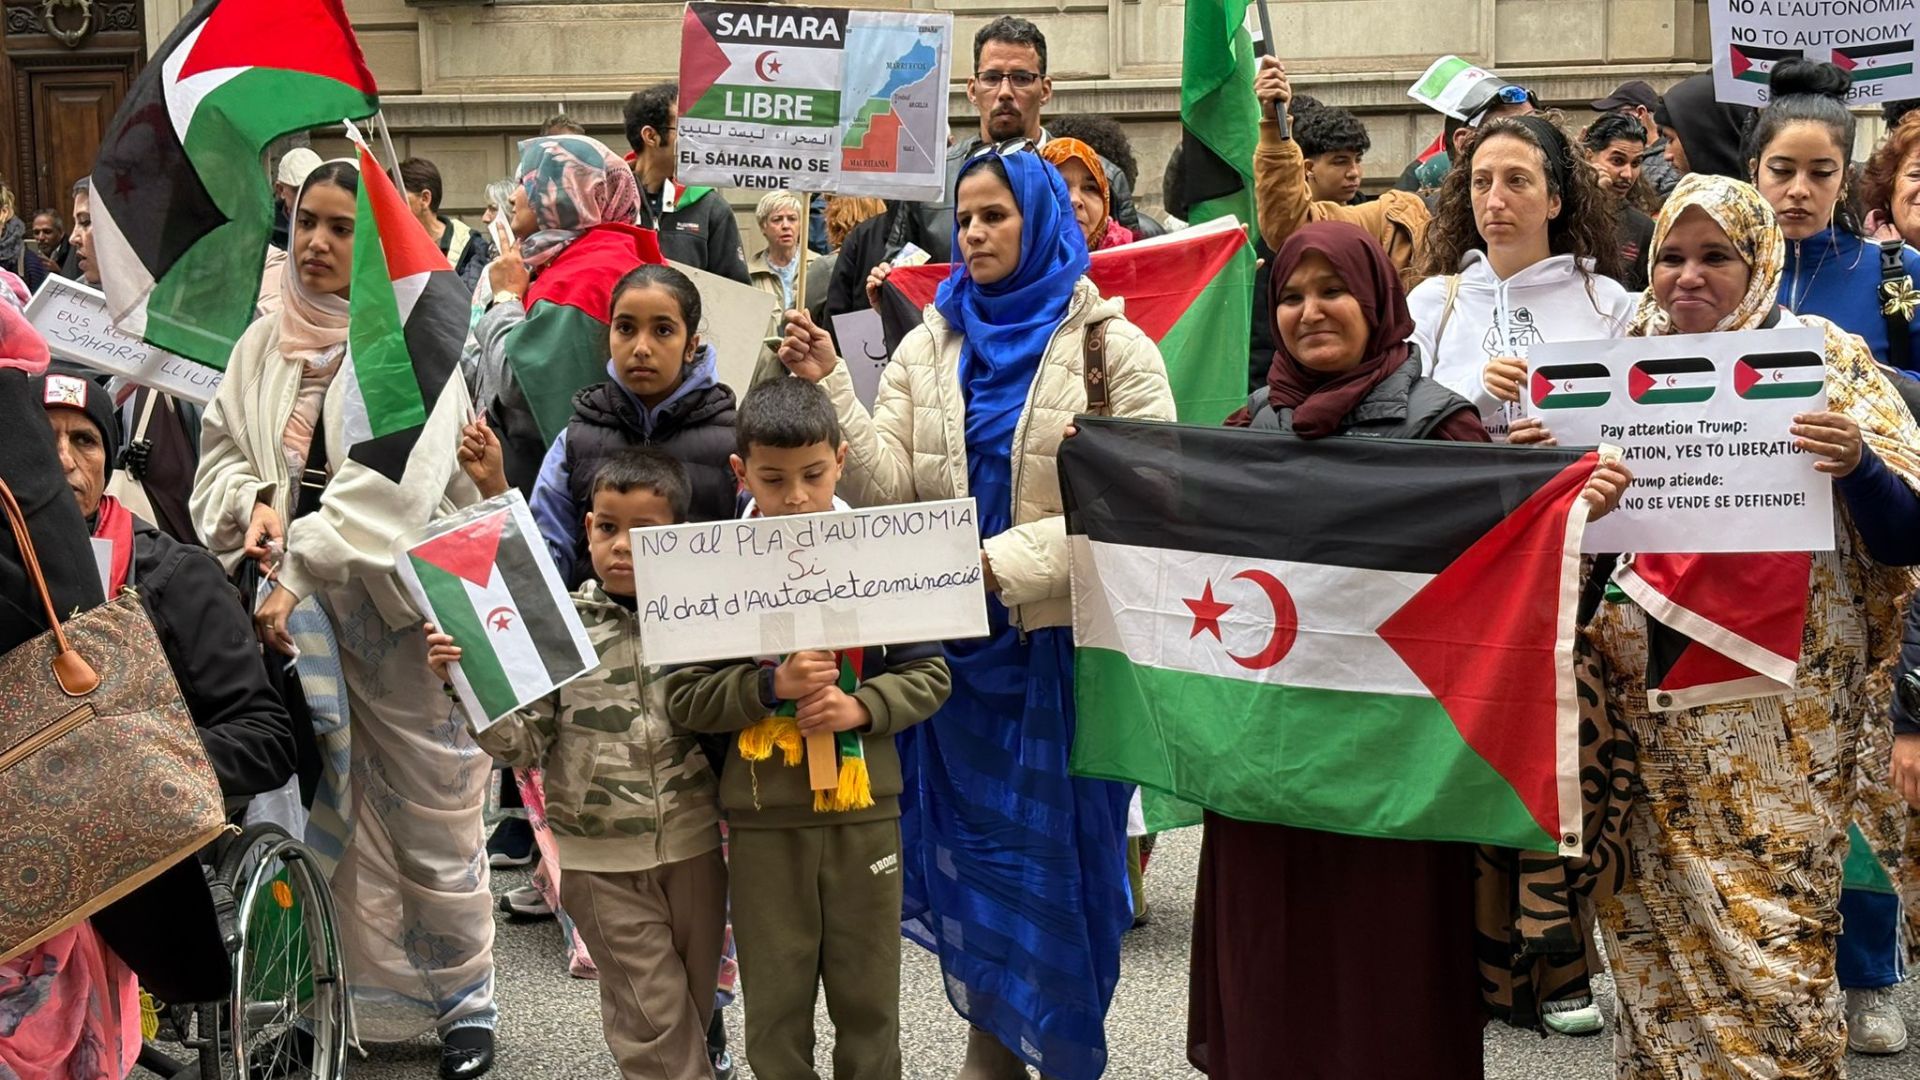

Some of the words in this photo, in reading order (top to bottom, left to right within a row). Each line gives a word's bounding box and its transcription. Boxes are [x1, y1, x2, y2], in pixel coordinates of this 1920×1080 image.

[1729, 0, 1754, 14] NO
[1759, 1, 1772, 16] A
[715, 12, 841, 41] SAHARA
[1731, 26, 1757, 43] NO
[1762, 29, 1788, 46] TO
[1793, 22, 1913, 46] AUTONOMY
[725, 91, 814, 121] LIBRE
[678, 123, 722, 139] للبيع
[728, 126, 766, 143] ليست
[775, 131, 833, 146] الصحراء
[680, 150, 700, 165] EL
[778, 156, 802, 171] NO
[807, 158, 830, 172] SE
[733, 174, 790, 189] VENDE
[161, 361, 223, 389] LLIUR
[1601, 424, 1625, 440] Pay
[1628, 421, 1693, 437] attention
[1697, 419, 1748, 439] Trump:
[1675, 444, 1702, 459] YES
[1706, 443, 1724, 458] TO
[1630, 475, 1666, 490] rump
[1669, 472, 1724, 488] atiende:
[1625, 497, 1644, 510] NO
[1647, 496, 1664, 510] SE
[1667, 495, 1710, 509] VENDE
[1713, 494, 1731, 508] SE
[1734, 492, 1806, 507] DEFIENDE!
[641, 530, 678, 557] NO
[736, 524, 783, 556] PLA
[643, 594, 670, 623] Al
